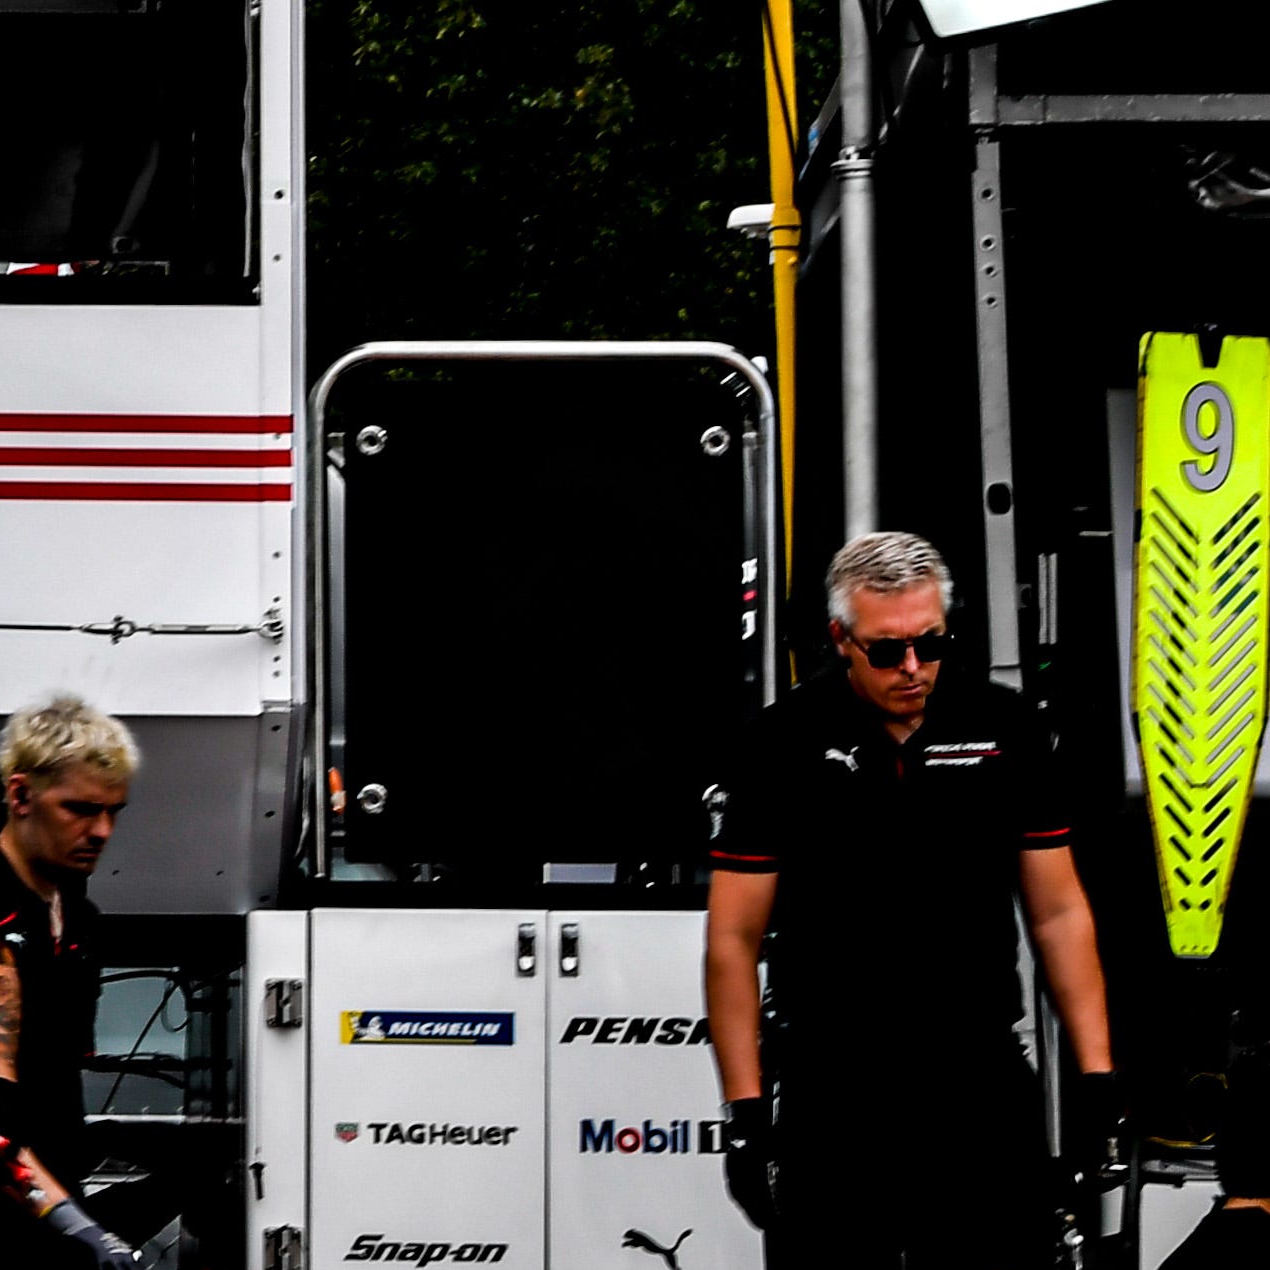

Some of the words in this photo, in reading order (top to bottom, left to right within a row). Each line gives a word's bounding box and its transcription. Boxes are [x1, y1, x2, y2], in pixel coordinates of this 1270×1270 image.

[1179, 380, 1236, 494] 9
[387, 1021, 503, 1037] MICHELIN
[559, 1016, 714, 1046] PENSK
[579, 1118, 692, 1154] Mobil
[343, 1233, 510, 1269] Snap-on
